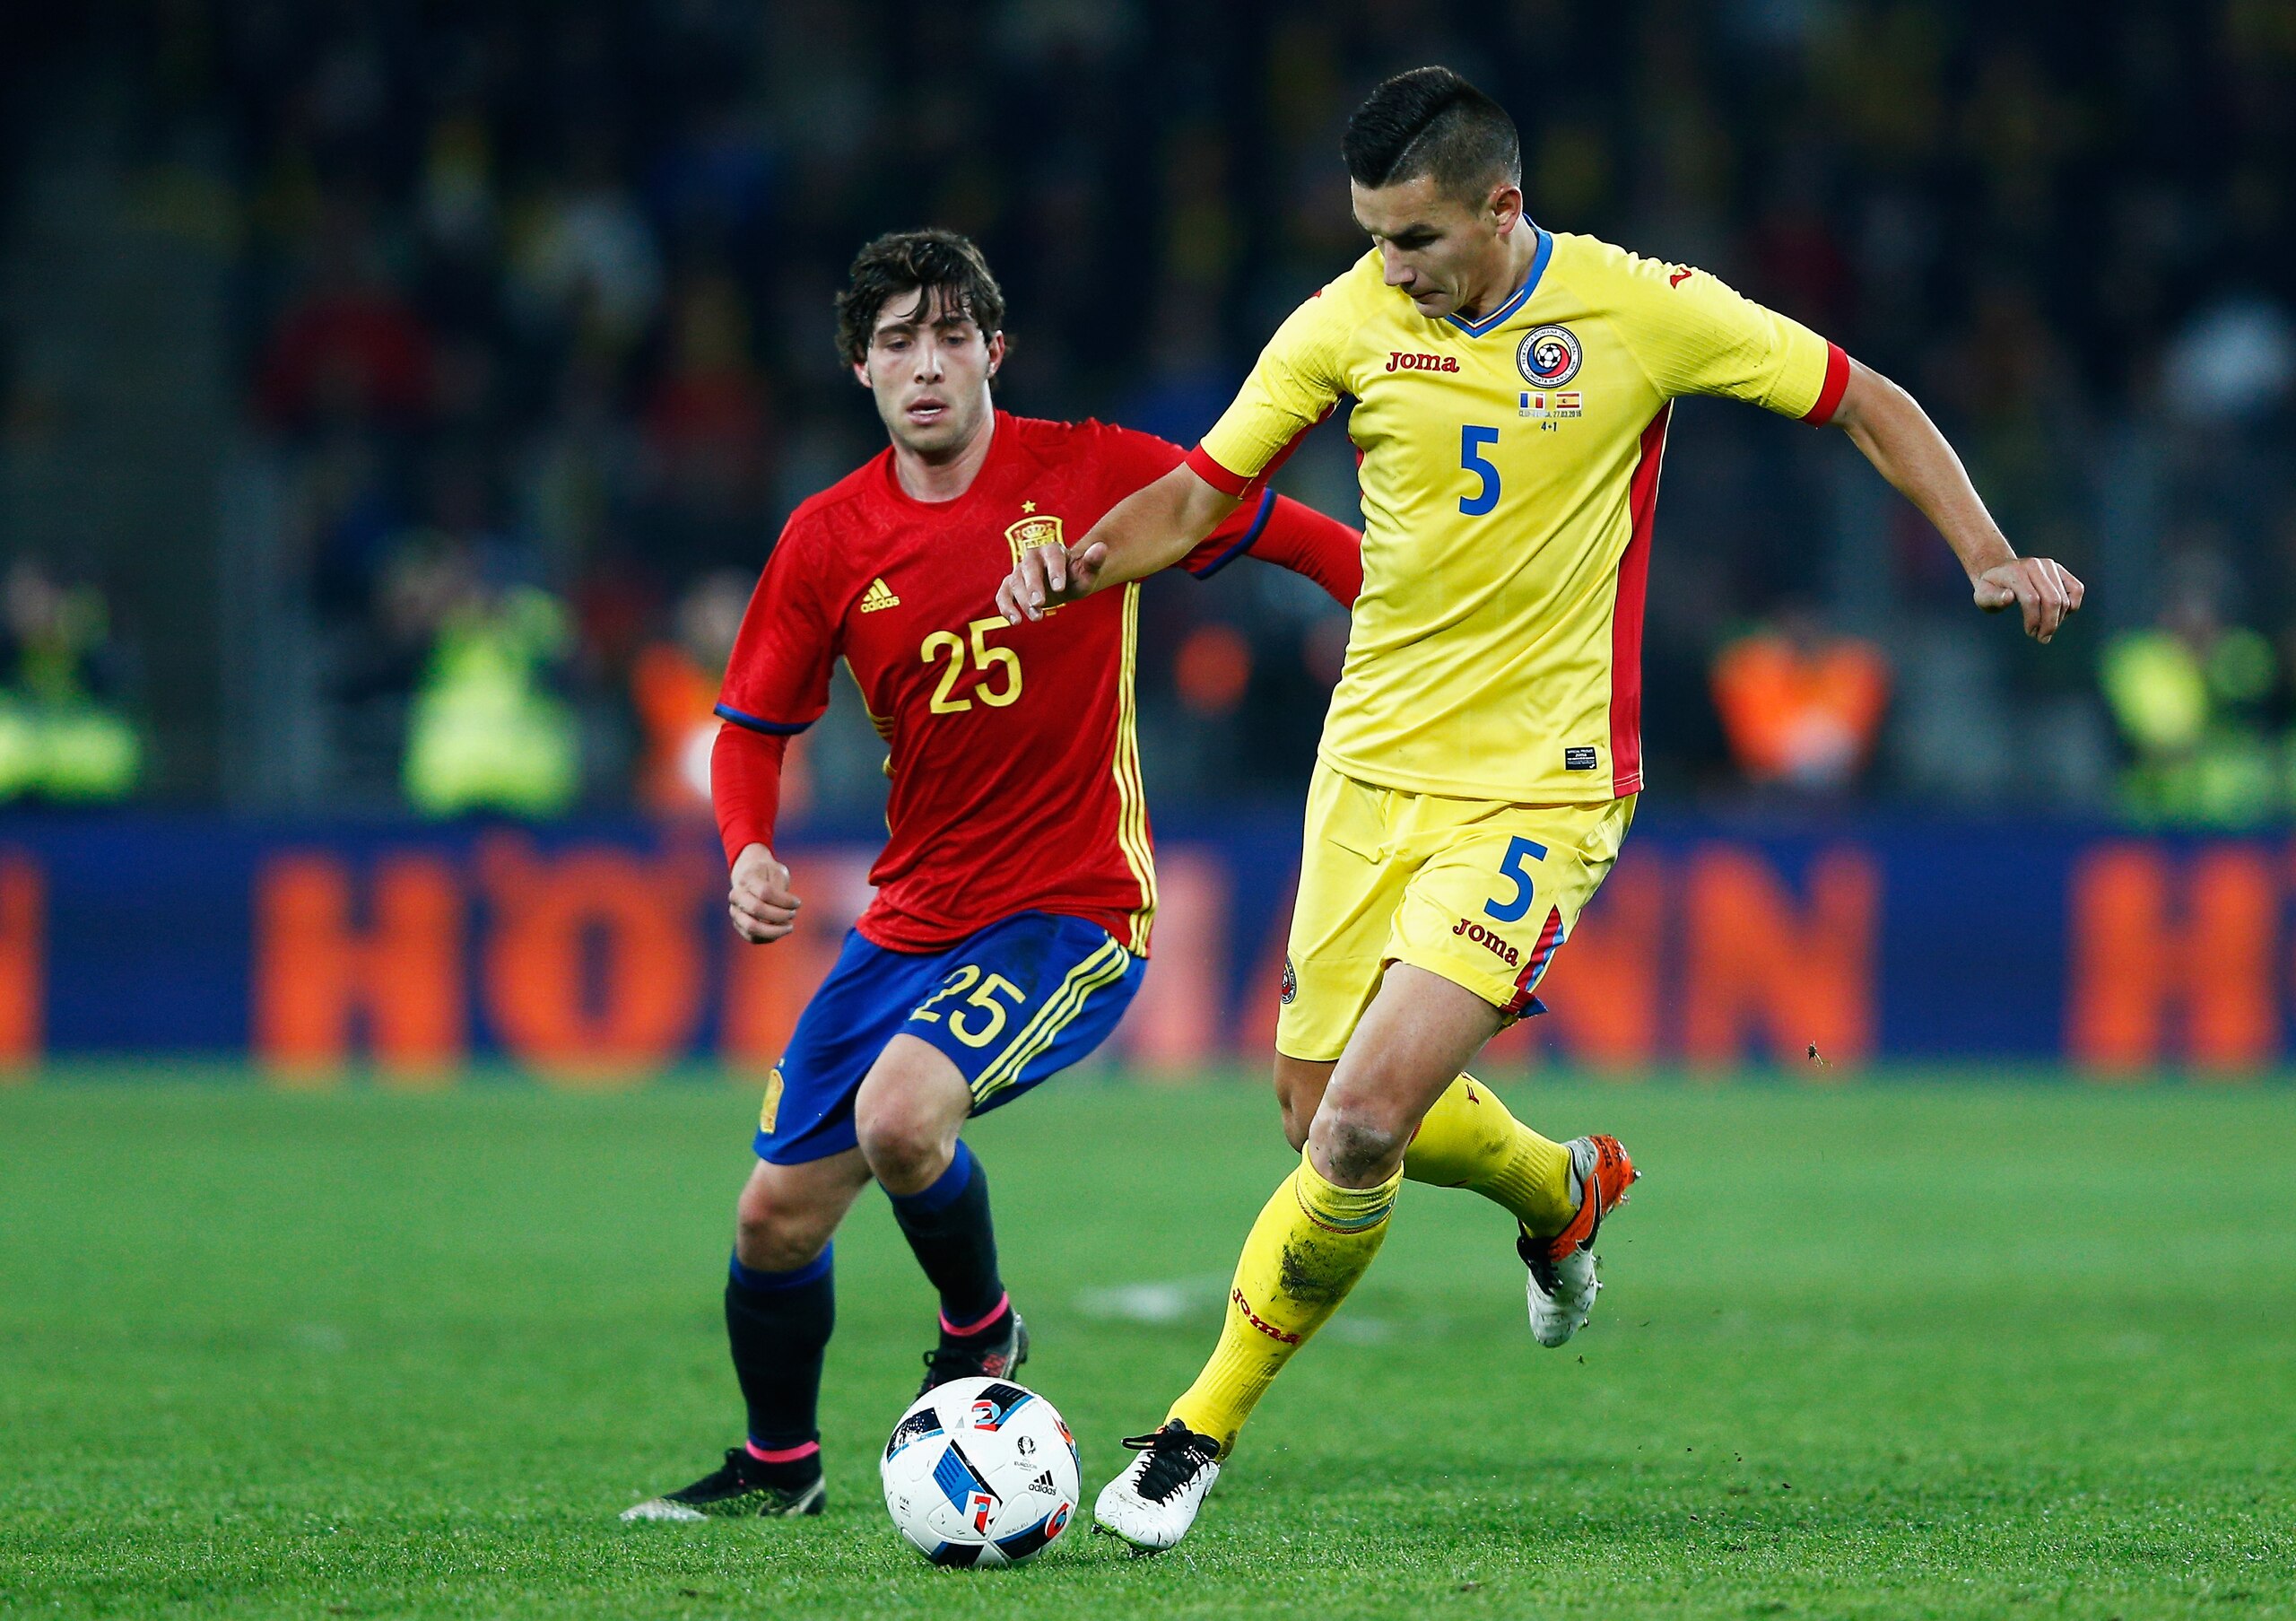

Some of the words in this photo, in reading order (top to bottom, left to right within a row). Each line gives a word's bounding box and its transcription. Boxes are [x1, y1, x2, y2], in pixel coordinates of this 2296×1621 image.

[1386, 352, 1460, 373] Joma
[1459, 424, 1501, 517] 5
[860, 596, 900, 614] adidas
[920, 615, 1023, 714] 25
[1483, 835, 1548, 922] 5
[256, 834, 1882, 1076] HÖNN
[1453, 918, 1520, 967] Joma
[909, 964, 1027, 1049] 25
[1028, 1483, 1057, 1496] adidas
